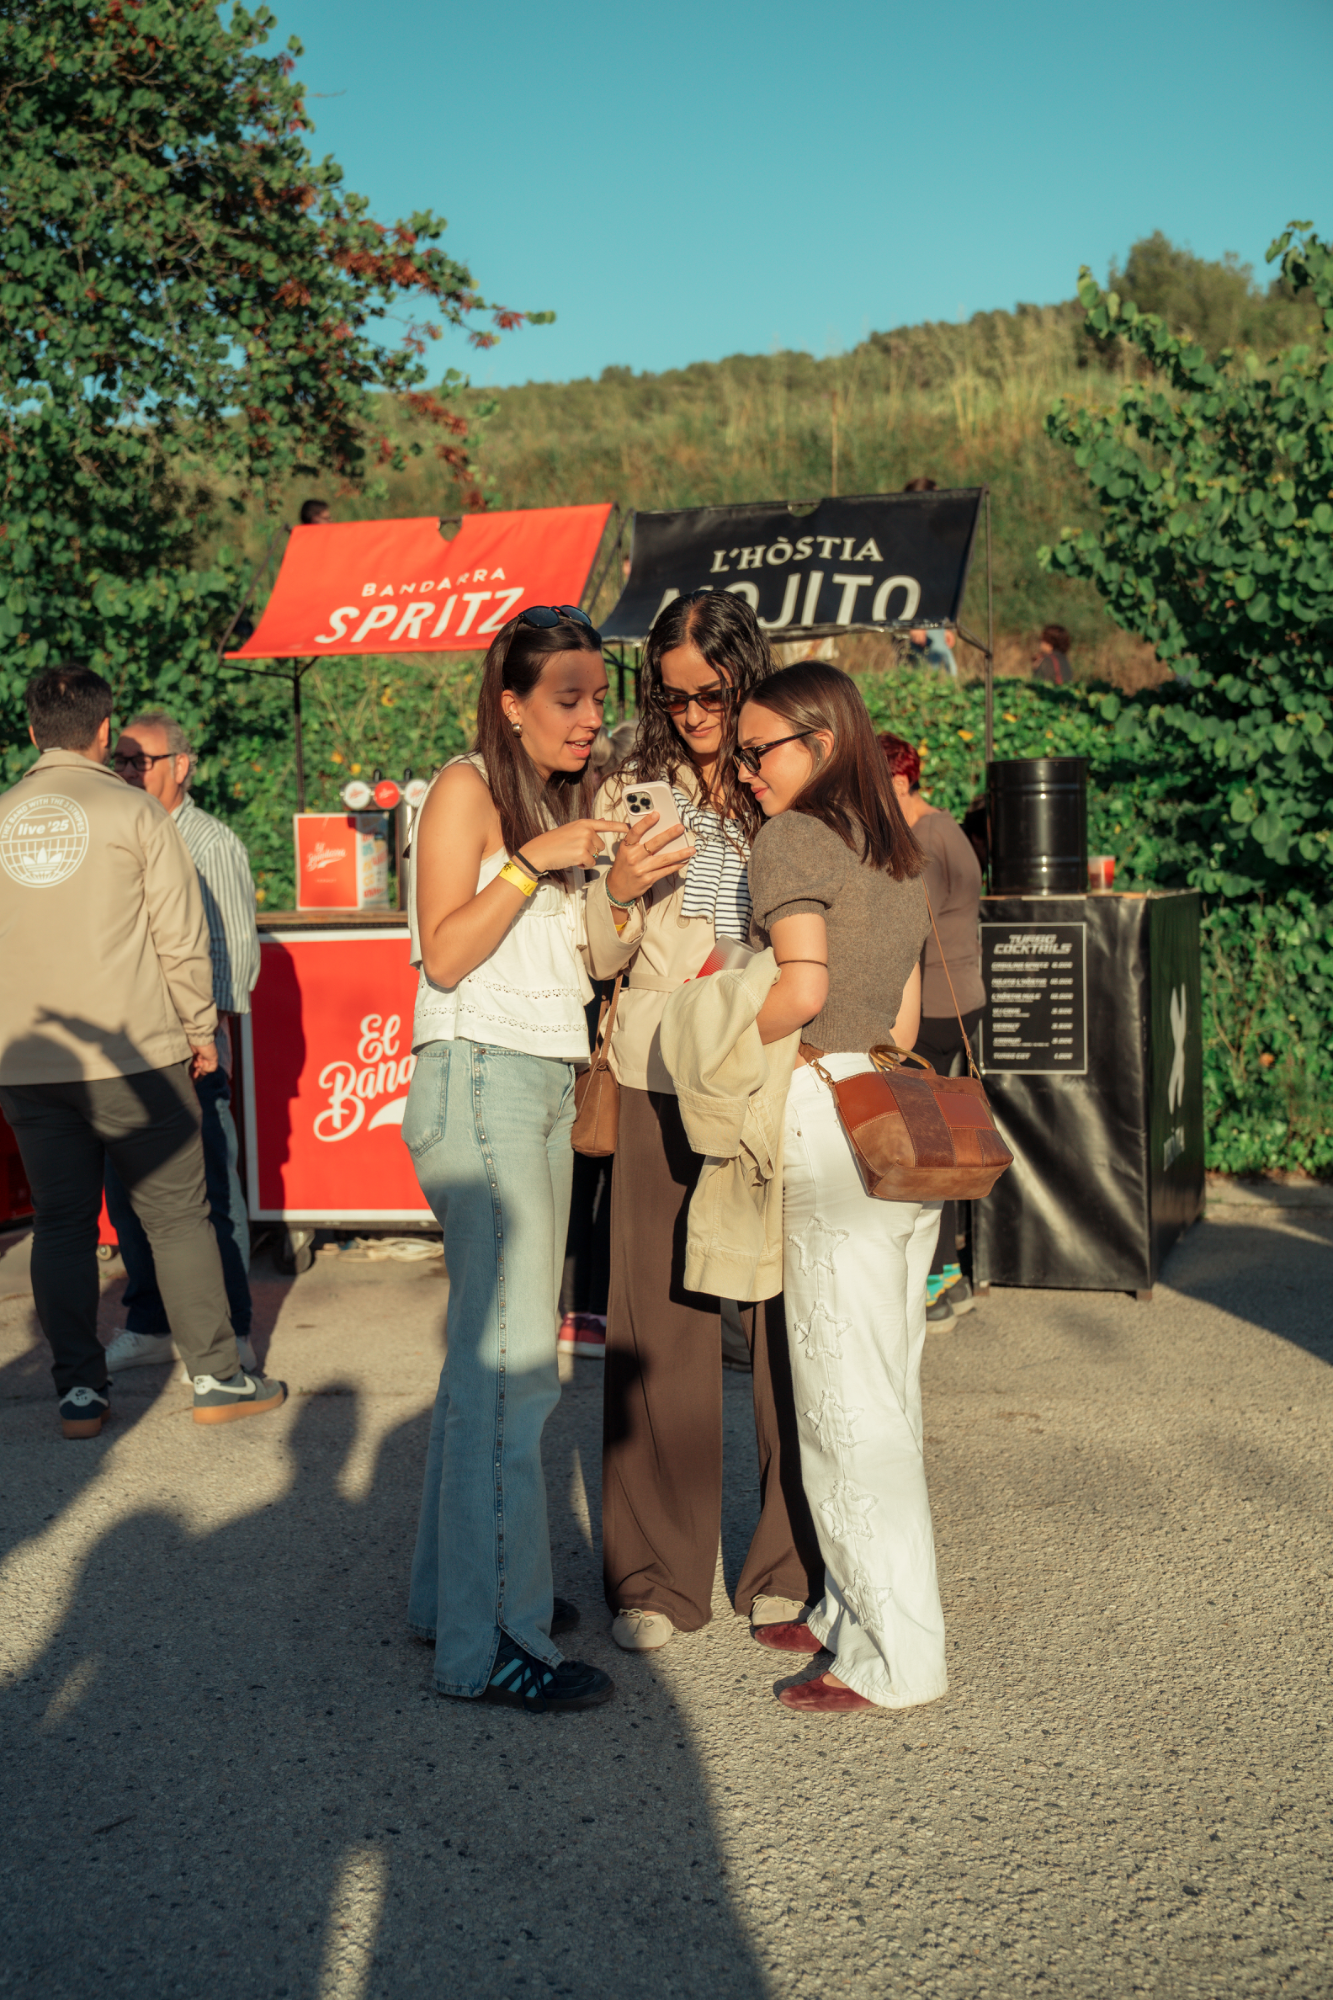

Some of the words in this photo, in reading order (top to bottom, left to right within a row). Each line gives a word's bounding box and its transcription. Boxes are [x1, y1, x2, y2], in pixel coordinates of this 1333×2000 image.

[709, 535, 884, 574] L'HÒSTIA
[361, 567, 506, 598] BANDARRA
[648, 570, 922, 631] JITO
[314, 587, 525, 644] SPRITZ
[18, 823, 45, 836] live
[993, 943, 1073, 955] COCKTAILS
[357, 1013, 401, 1064] El
